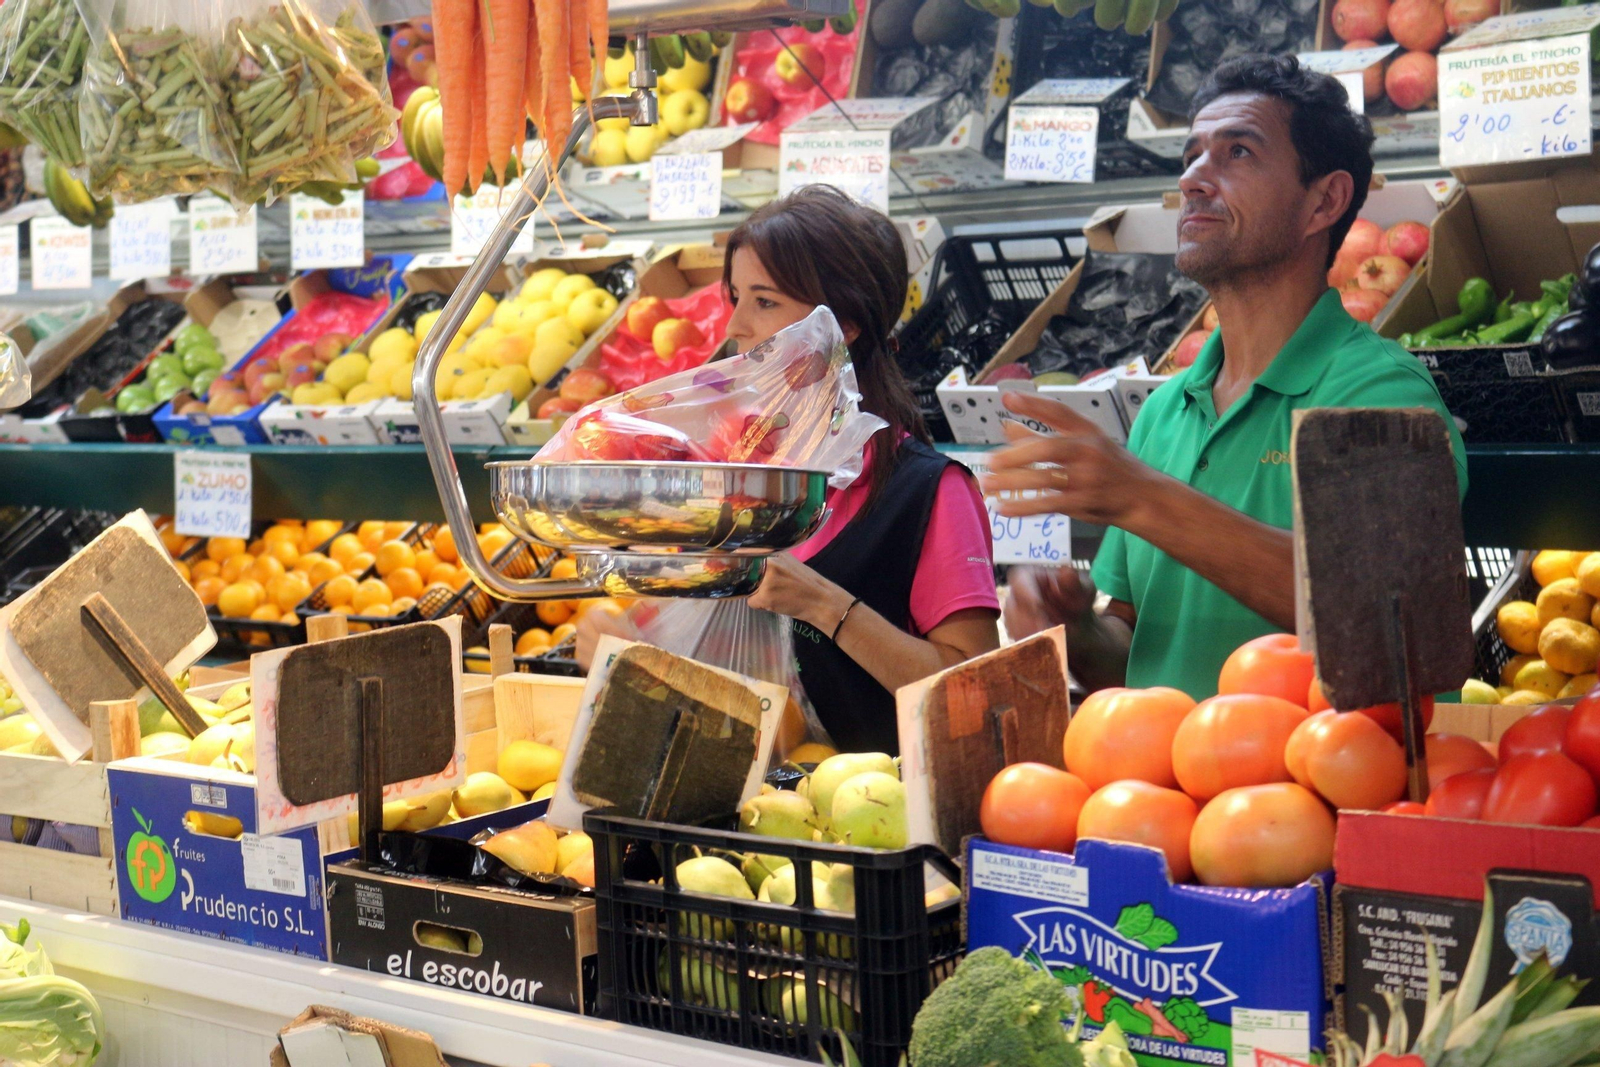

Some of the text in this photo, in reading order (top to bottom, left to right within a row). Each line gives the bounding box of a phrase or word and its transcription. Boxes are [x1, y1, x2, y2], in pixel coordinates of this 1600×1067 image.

[1513, 54, 1528, 63] EL
[1531, 46, 1581, 61] PINCHO
[1482, 61, 1580, 86] PIMIENTOS
[1482, 81, 1577, 105] ITALIANOS
[1033, 120, 1092, 132] MANGO
[197, 471, 247, 490] ZUMO
[173, 838, 206, 862] fruites
[181, 868, 278, 929] Prudencio
[284, 907, 314, 936] S.L.
[1038, 923, 1200, 996] LAS VIRTUDES
[386, 949, 543, 1003] el escobar
[1149, 1040, 1162, 1055] DE
[1162, 1042, 1180, 1059] LAS
[1181, 1046, 1226, 1066] VIRTUDES
